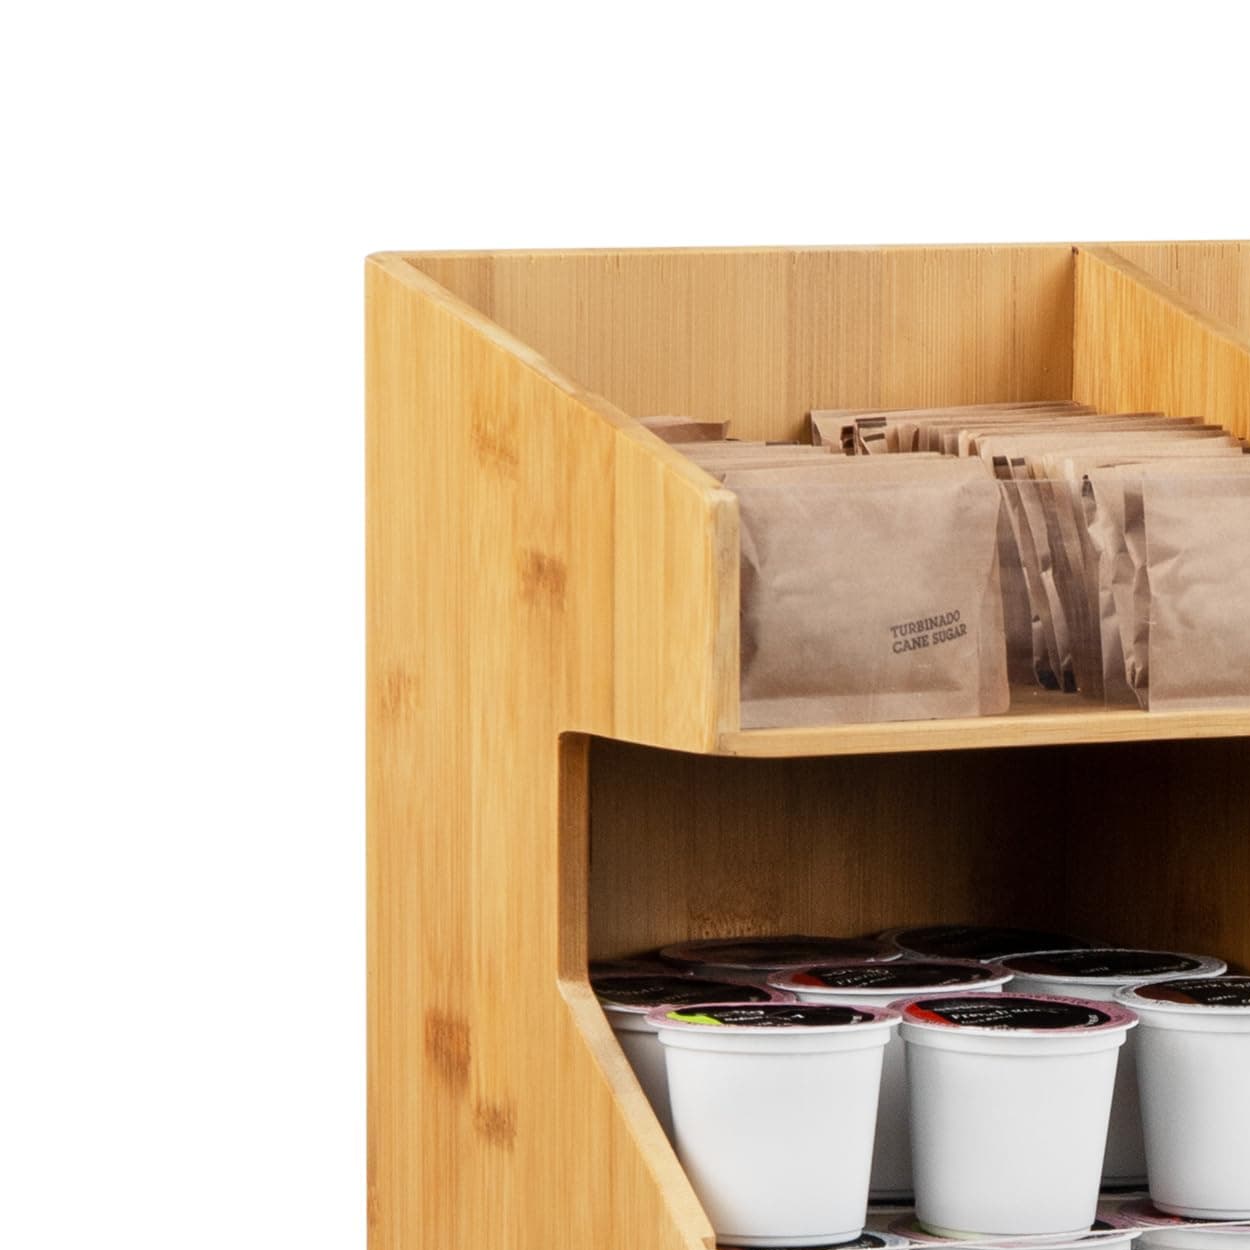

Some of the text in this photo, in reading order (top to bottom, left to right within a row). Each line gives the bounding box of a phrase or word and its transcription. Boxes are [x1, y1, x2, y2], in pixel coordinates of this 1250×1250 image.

[890, 609, 961, 638] TURBINADO
[892, 623, 967, 654] CANE SUGAR
